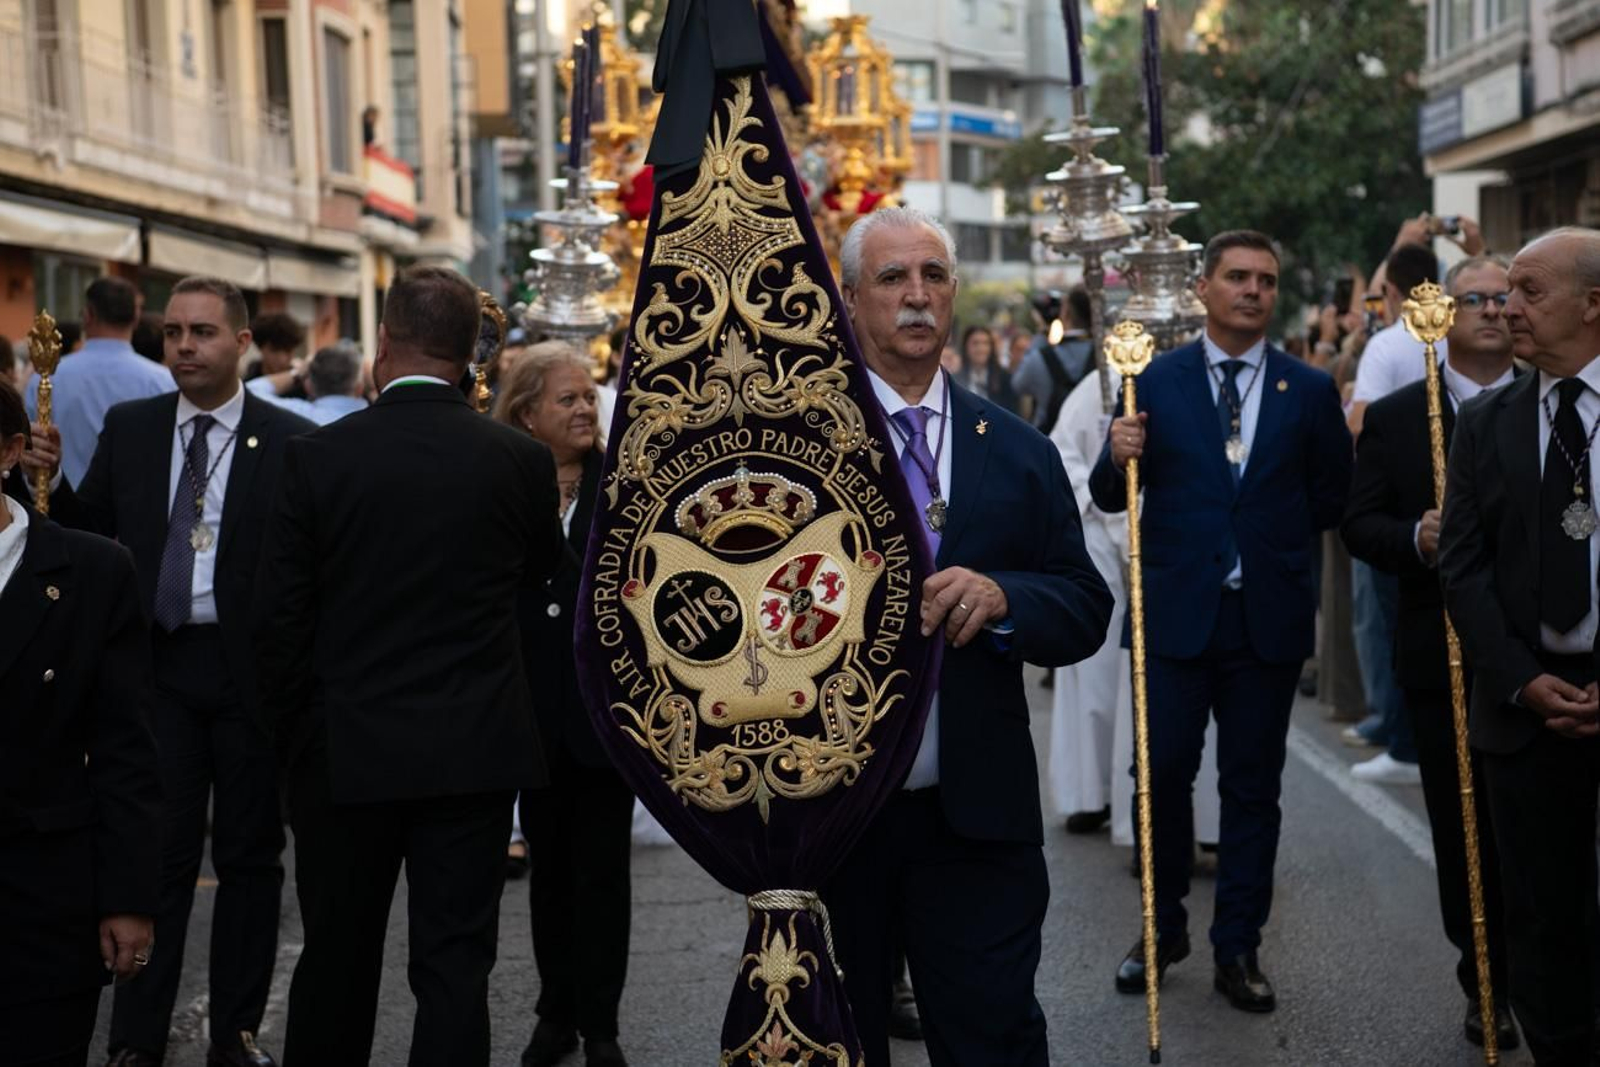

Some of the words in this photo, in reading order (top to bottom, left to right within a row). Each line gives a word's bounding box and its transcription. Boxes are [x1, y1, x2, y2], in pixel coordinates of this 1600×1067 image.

[593, 526, 634, 646] COFRADIA
[621, 491, 654, 525] DE
[649, 429, 752, 494] NUESTRO
[760, 428, 838, 474] PADRE
[837, 464, 896, 529] JESUS
[869, 533, 911, 666] NAZARENO
[731, 719, 790, 748] 1588
